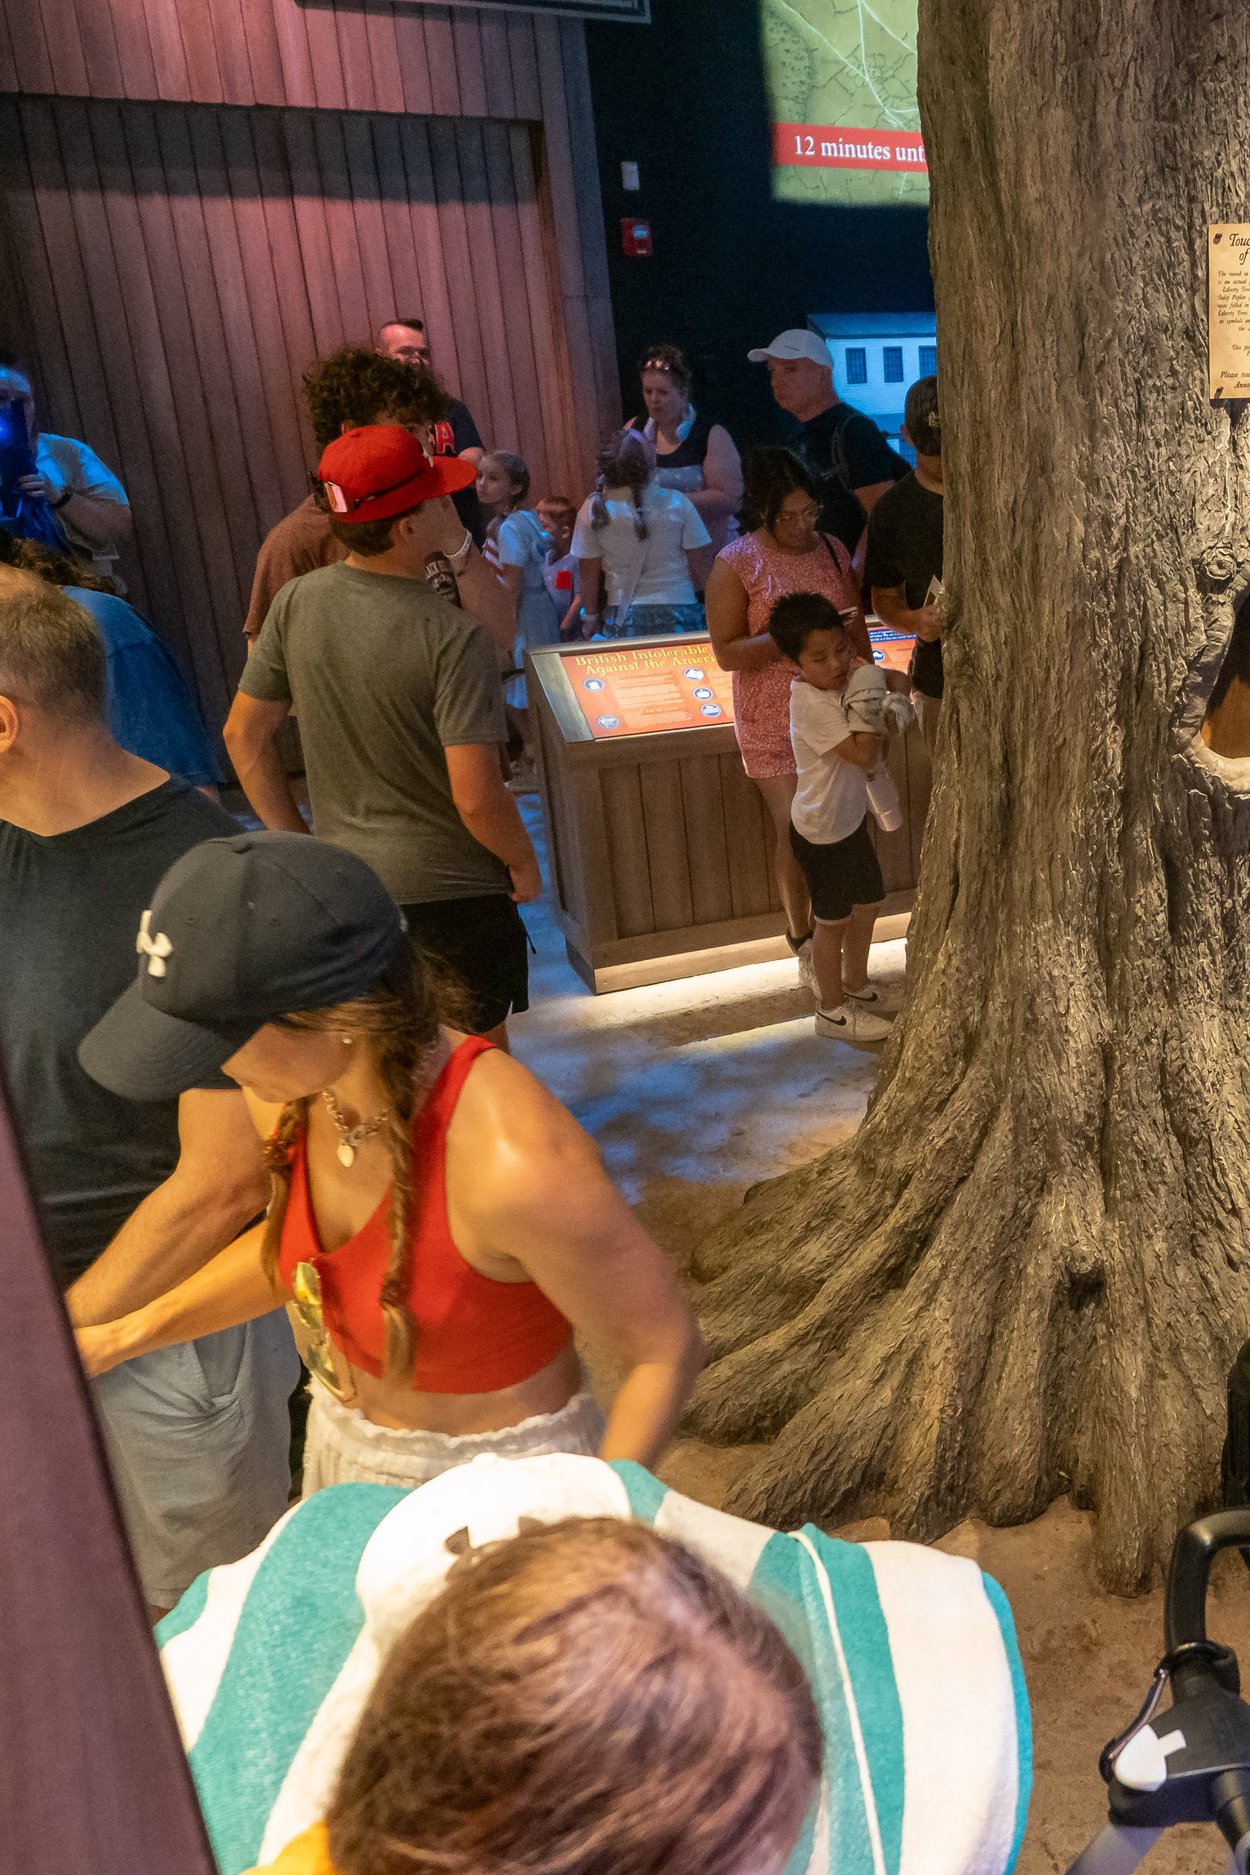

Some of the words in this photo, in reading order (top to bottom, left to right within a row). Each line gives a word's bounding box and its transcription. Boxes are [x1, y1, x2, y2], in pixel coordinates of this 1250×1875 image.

[794, 135, 815, 156] 12
[820, 137, 891, 160] minutes
[895, 144, 926, 162] unt
[1238, 248, 1250, 265] of
[575, 652, 628, 667] British
[632, 644, 709, 661] Intolerable
[585, 660, 640, 677] Against
[644, 658, 666, 670] the
[672, 655, 717, 667] Ameri
